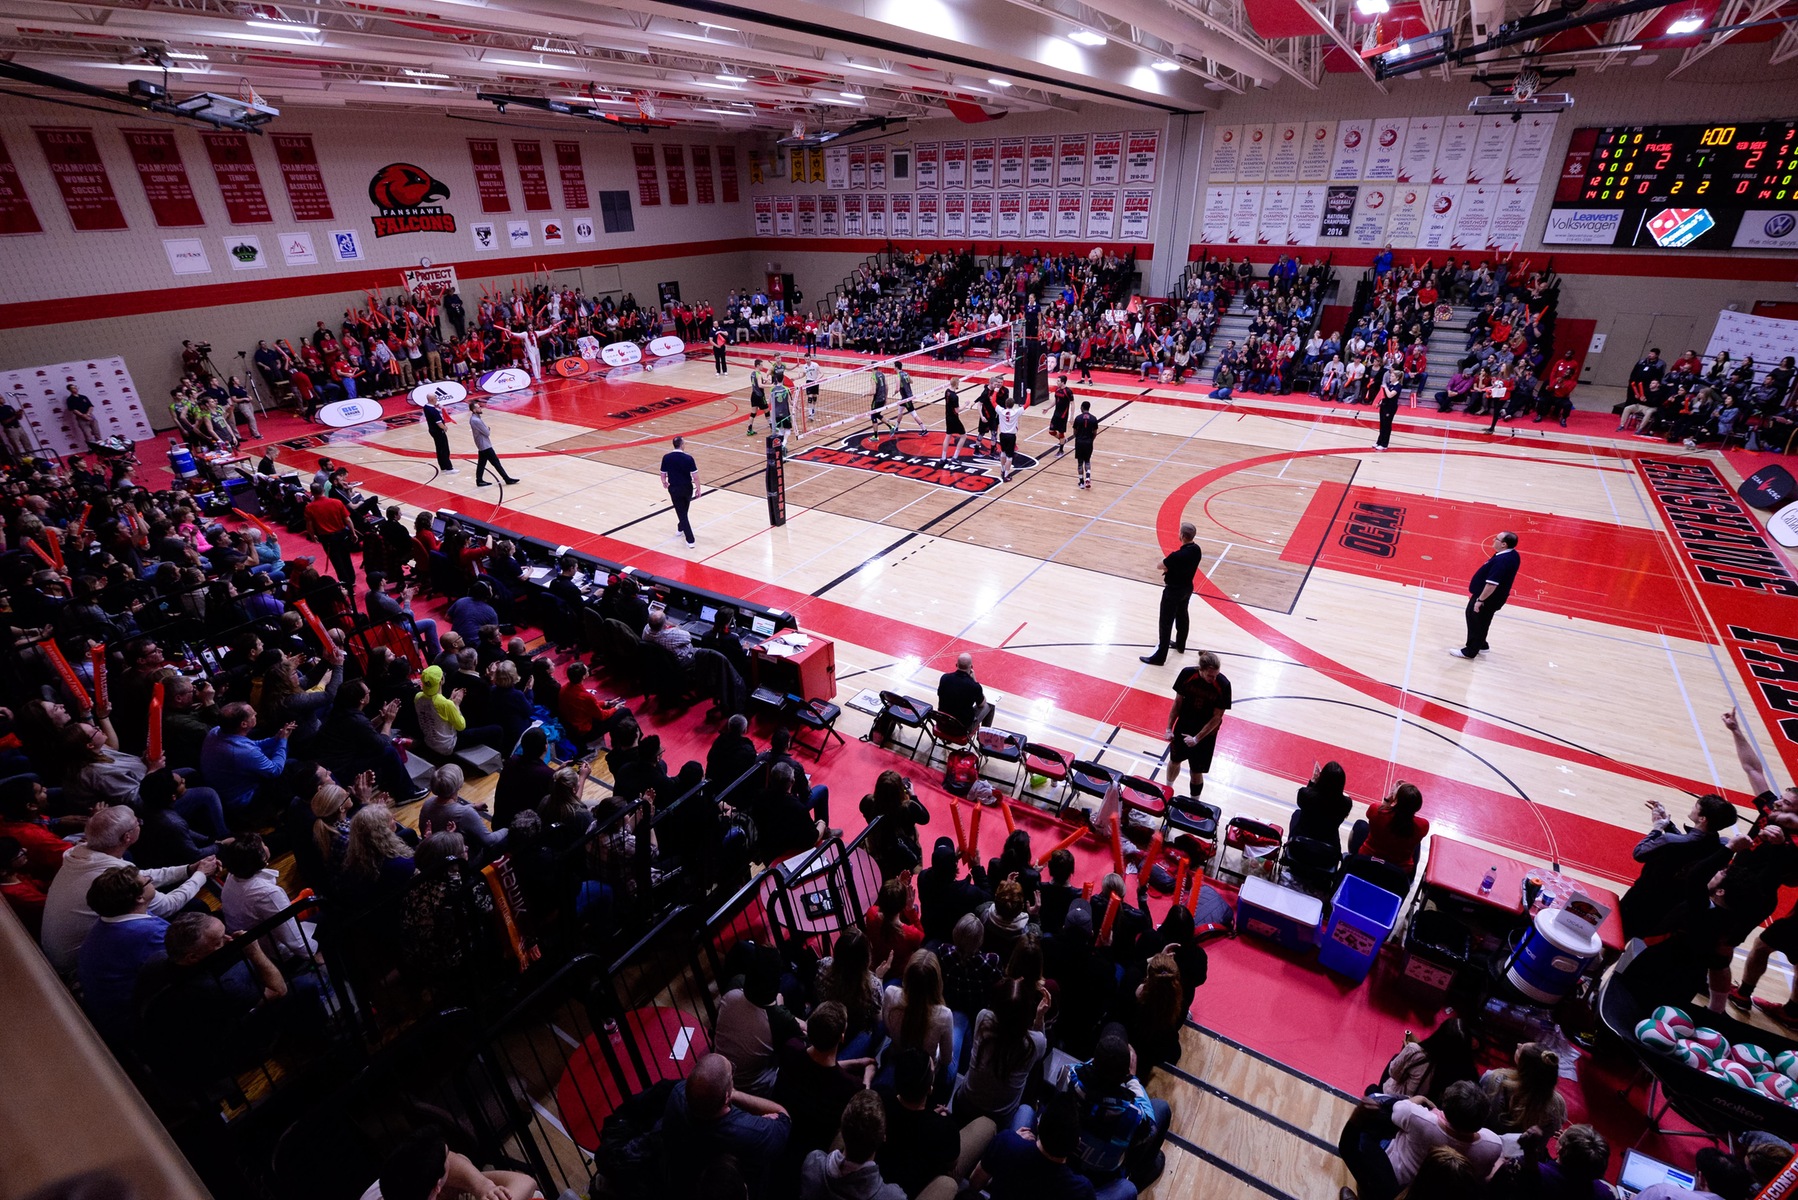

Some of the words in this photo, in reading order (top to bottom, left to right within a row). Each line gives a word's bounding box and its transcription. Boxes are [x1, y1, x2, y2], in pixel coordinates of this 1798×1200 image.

[1609, 135, 1615, 143] 1
[1619, 135, 1627, 144] 0
[1634, 134, 1643, 144] 0
[1700, 127, 1736, 145] 1:00
[1785, 130, 1795, 140] 3
[1095, 141, 1120, 149] OCAA
[1130, 138, 1156, 147] OCAA
[1601, 150, 1609, 158] 6
[1614, 149, 1623, 158] 0
[1632, 149, 1638, 157] 1
[1780, 145, 1789, 155] 5
[1655, 153, 1671, 170] 2
[1698, 156, 1705, 167] 1
[1745, 151, 1762, 168] 2
[1776, 160, 1784, 169] 7
[1788, 160, 1798, 170] 0
[51, 164, 105, 172] CHAMPIONS
[137, 164, 184, 172] CHAMPIONS
[214, 164, 256, 172] CHAMPIONS
[281, 163, 320, 172] CHAMPIONS
[1598, 163, 1606, 171] 9
[1610, 163, 1618, 172] 0
[1624, 162, 1634, 172] 0
[1590, 177, 1601, 186] 12
[1606, 177, 1614, 186] 0
[1620, 176, 1629, 186] 0
[1764, 176, 1777, 184] 11
[1782, 175, 1792, 185] 0
[71, 186, 104, 194] SOCCER
[1638, 181, 1650, 194] 0
[1670, 181, 1683, 194] 2
[1697, 181, 1710, 194] 2
[1736, 181, 1749, 194] 0
[1601, 190, 1610, 199] 0
[1616, 190, 1624, 199] 0
[1758, 190, 1772, 199] 14
[1776, 190, 1786, 200] 0
[1059, 198, 1080, 206] OCAA
[1091, 198, 1114, 206] OCAA
[1125, 198, 1149, 206] OCAA
[383, 208, 441, 216] FANSHAWE
[1573, 212, 1619, 221] Leavens
[372, 213, 456, 238] FALCONS
[1553, 218, 1616, 233] Volkswagen
[1327, 228, 1343, 236] 2016
[414, 269, 452, 282] PROTECT
[427, 280, 452, 292] NEST
[846, 448, 979, 474] FANSHAWE
[798, 448, 996, 492] FALCONS
[775, 450, 785, 520] FANSHAWE
[1751, 475, 1763, 485] CCAA
[1766, 488, 1781, 500] ACSC
[1339, 500, 1406, 559] OCAA
[1638, 458, 1798, 598] FANSHAWE
[1712, 1096, 1764, 1122] molten
